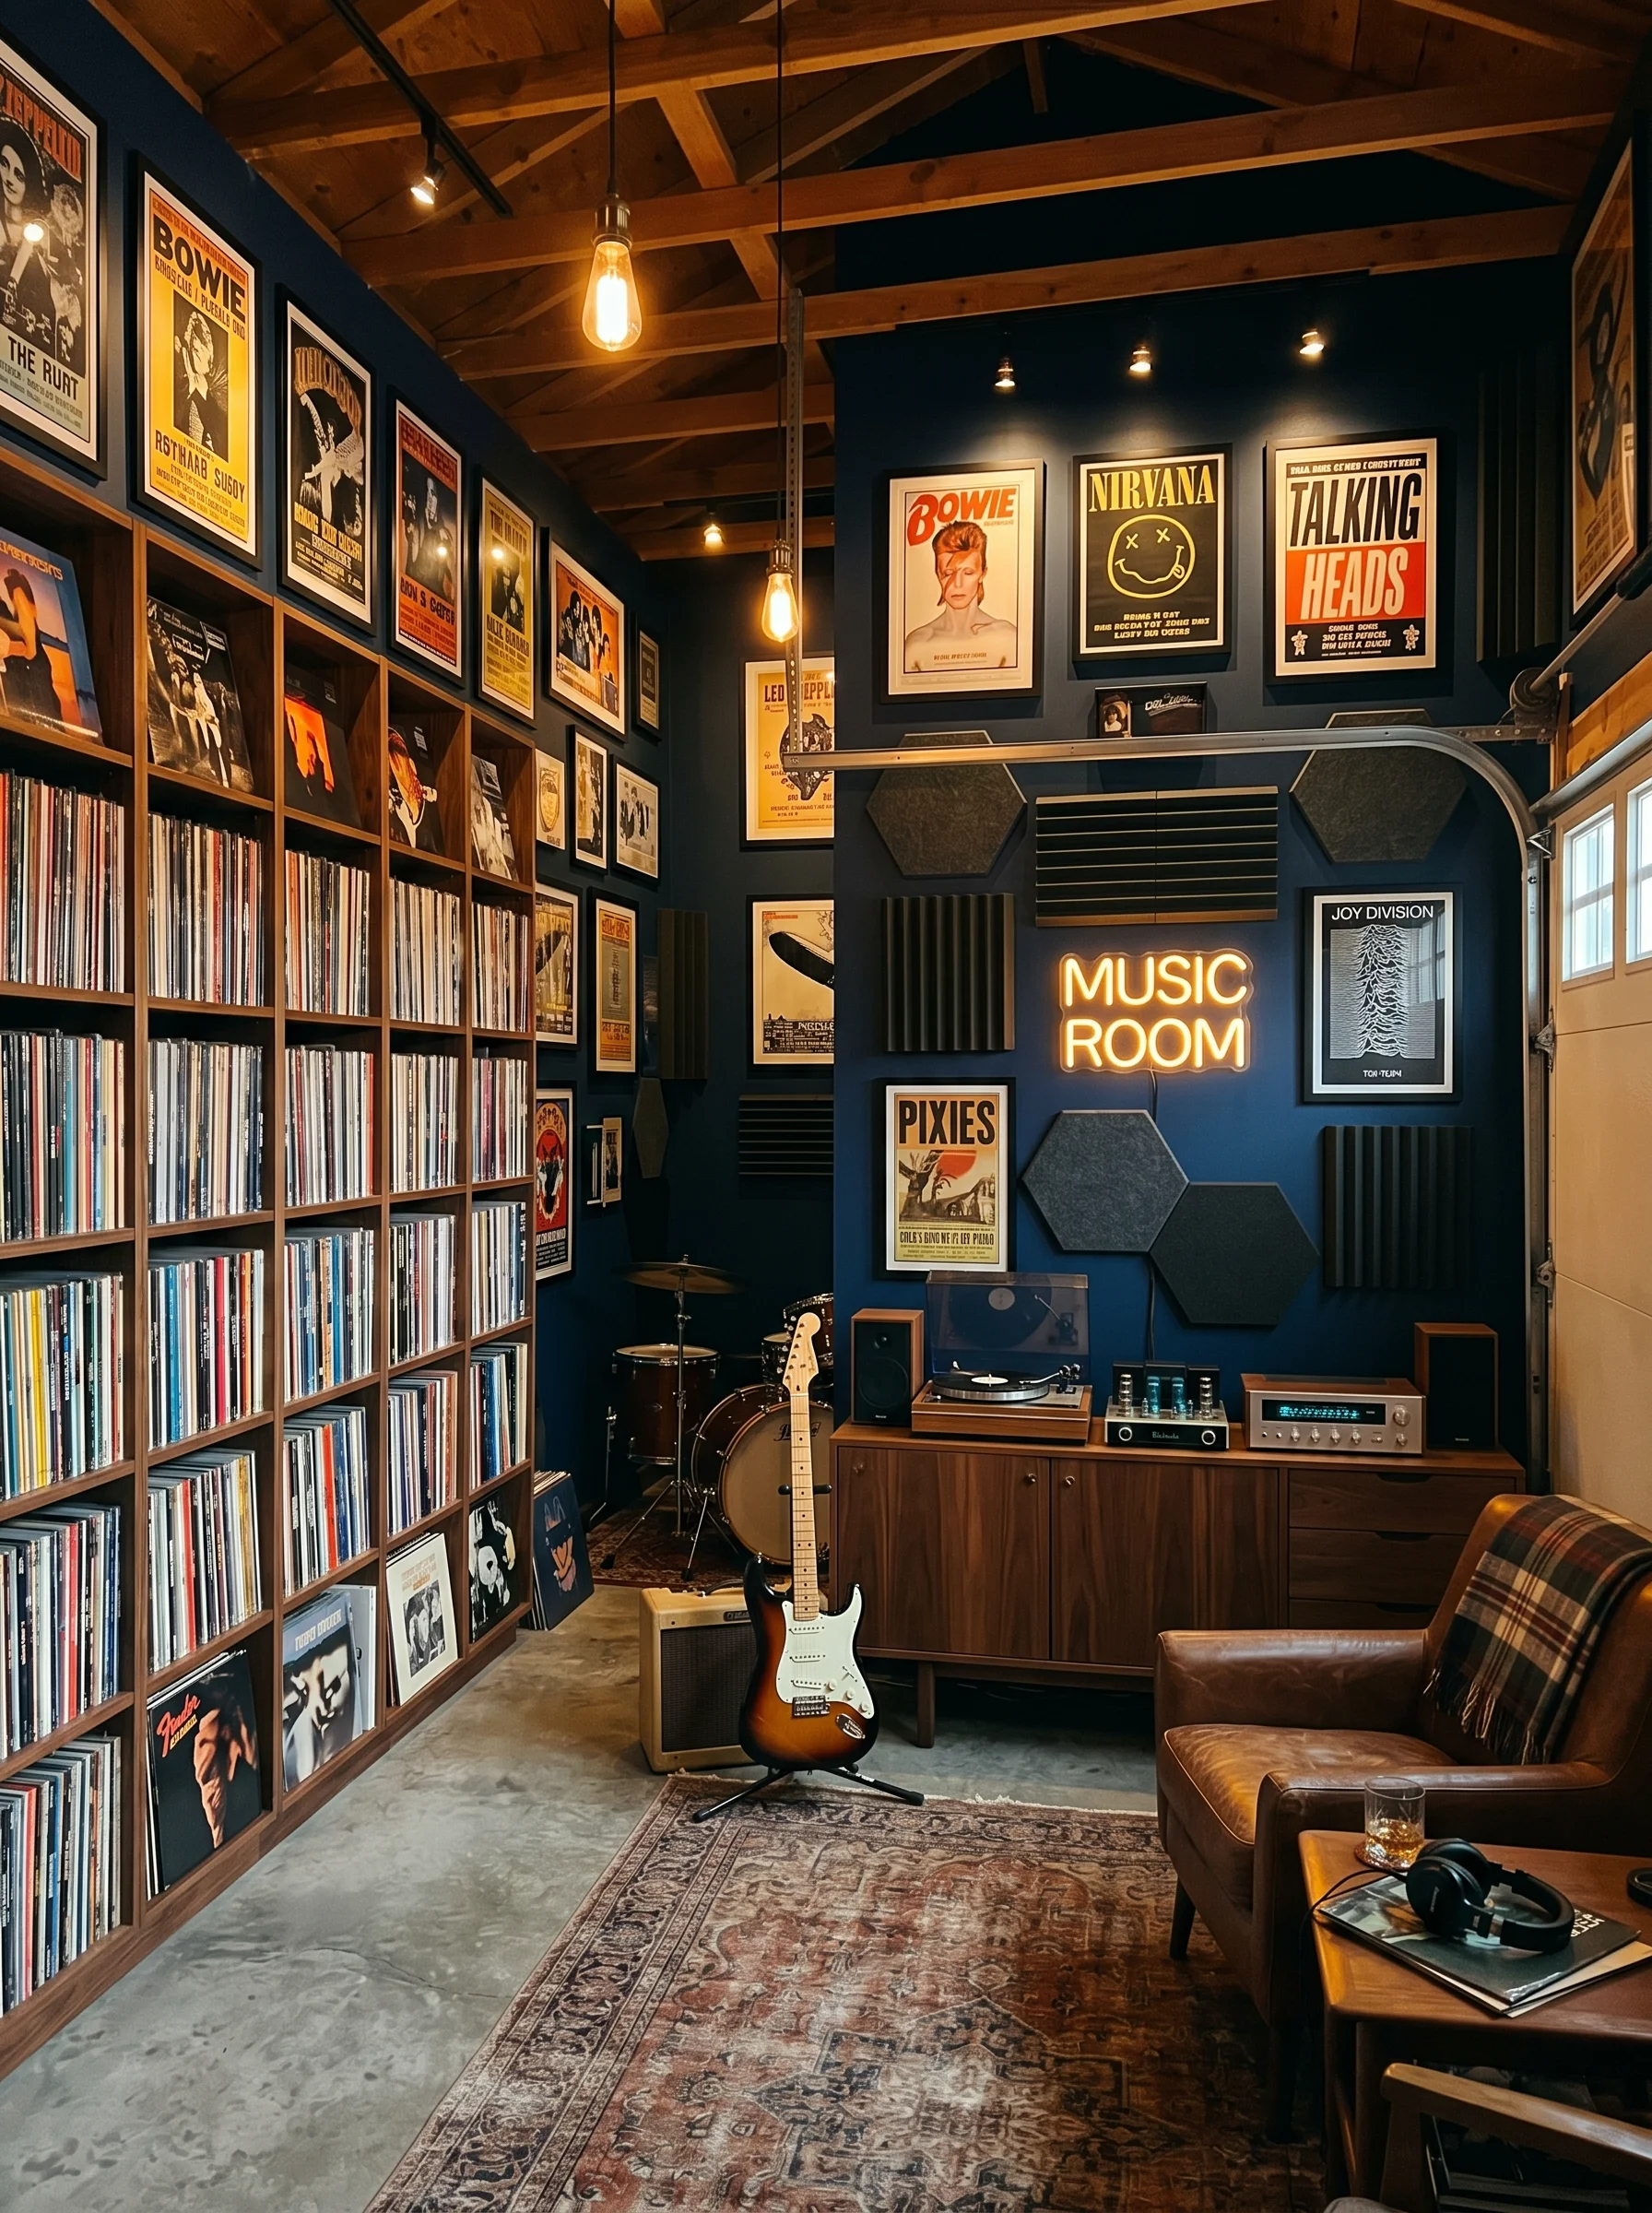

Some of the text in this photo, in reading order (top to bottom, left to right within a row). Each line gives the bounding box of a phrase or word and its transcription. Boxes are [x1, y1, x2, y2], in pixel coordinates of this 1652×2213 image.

[153, 213, 246, 324] BOWIE
[7, 335, 36, 375] THE
[1089, 465, 1216, 512] NIRVANA
[1290, 472, 1422, 547] TALKING
[907, 488, 1017, 546] BOWIE
[1300, 547, 1409, 621] HEADS
[764, 684, 785, 703] LED
[1331, 905, 1434, 920] JOY DIVISION
[1065, 953, 1247, 1007] MUSIC
[1066, 1018, 1245, 1068] ROOM
[899, 1100, 996, 1145] PIXIES
